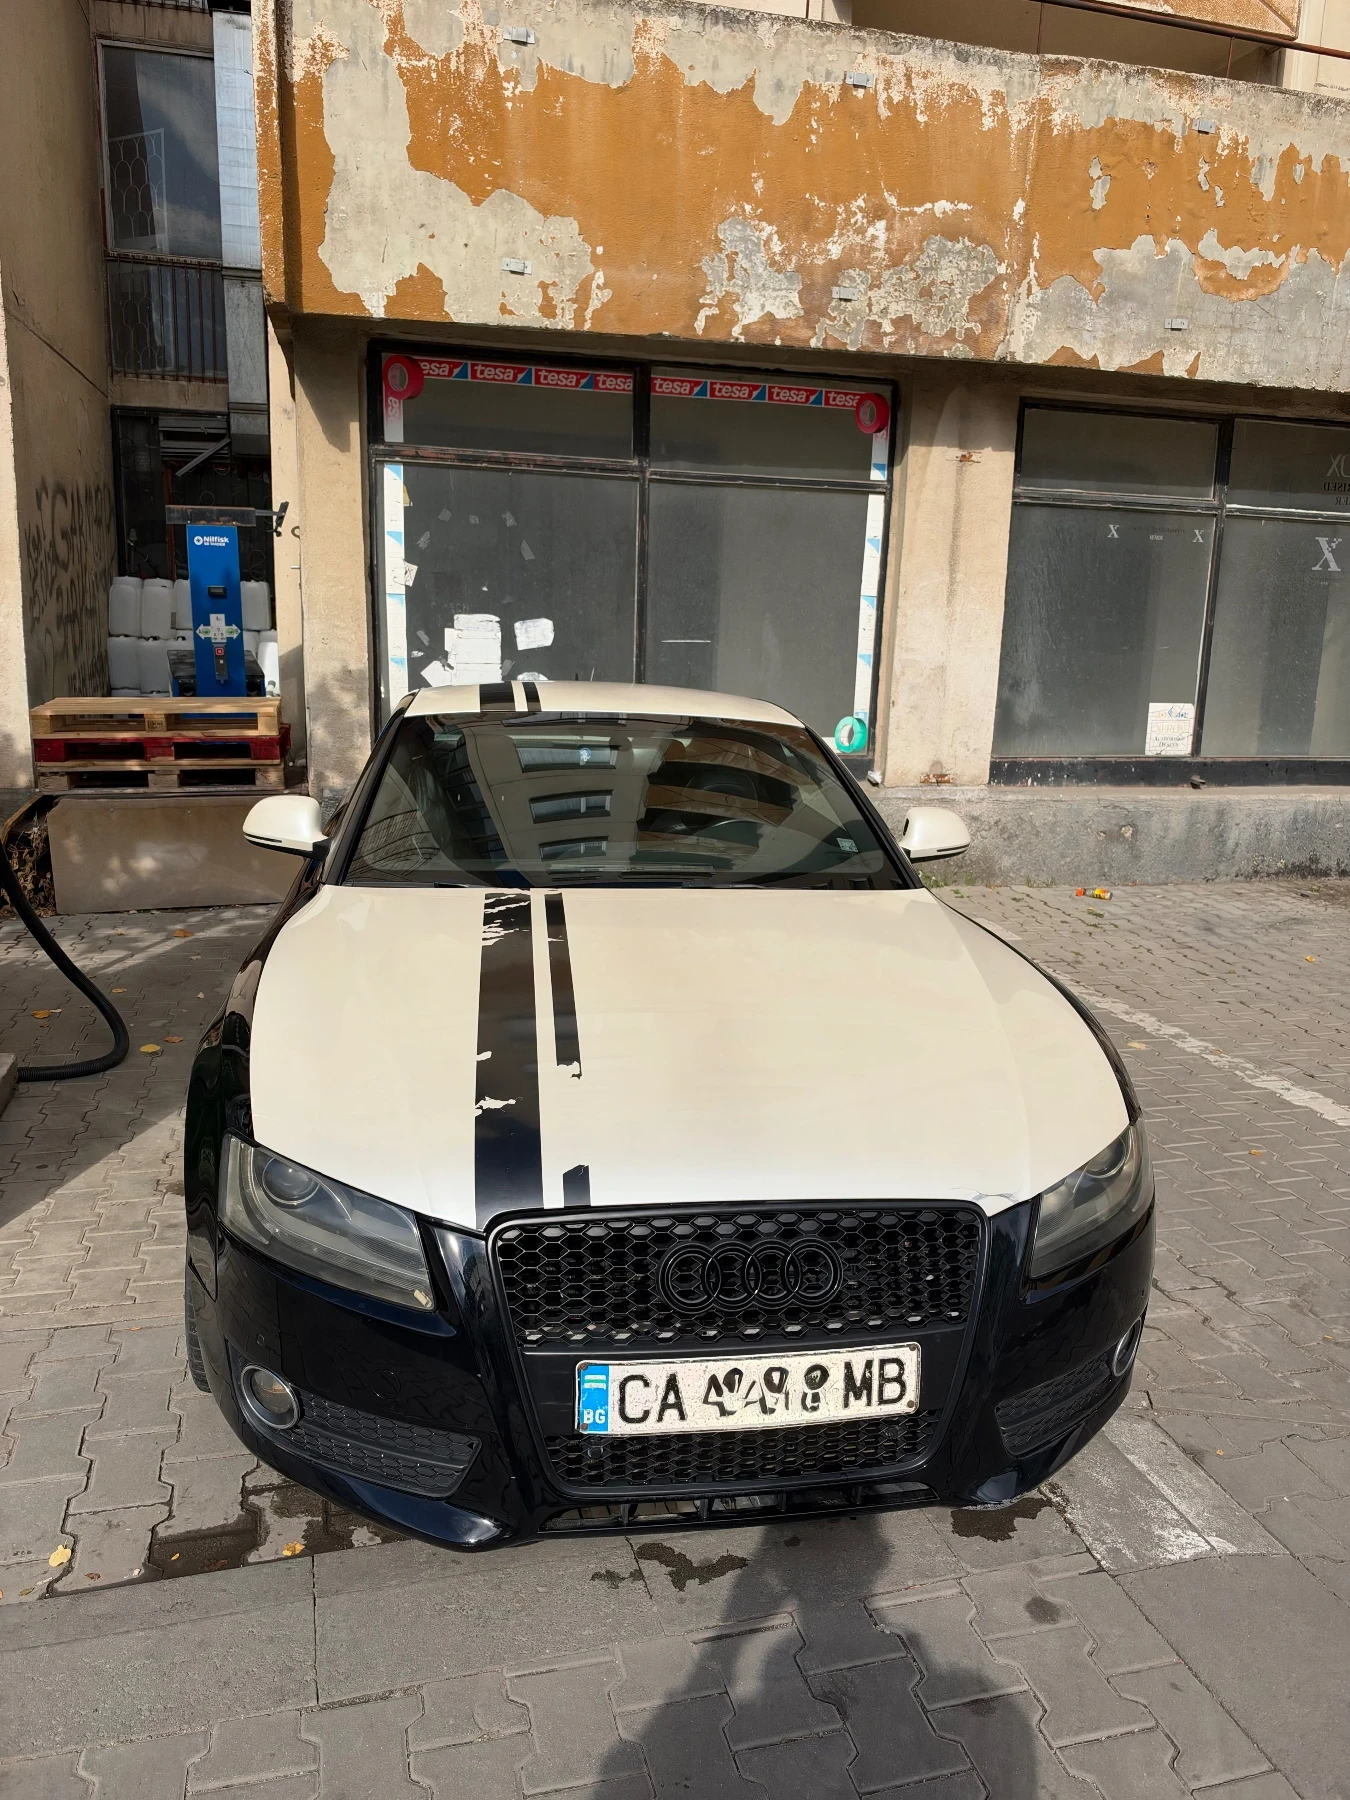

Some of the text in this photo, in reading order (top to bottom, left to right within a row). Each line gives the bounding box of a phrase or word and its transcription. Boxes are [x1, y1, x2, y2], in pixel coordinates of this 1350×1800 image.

[418, 361, 633, 391] esa tesa tesa tesa
[653, 378, 690, 395] tesa
[712, 382, 750, 399] tesa
[771, 387, 807, 403] tesa
[618, 1372, 687, 1424] CA
[843, 1358, 907, 1409] MB
[583, 1408, 606, 1425] BG
